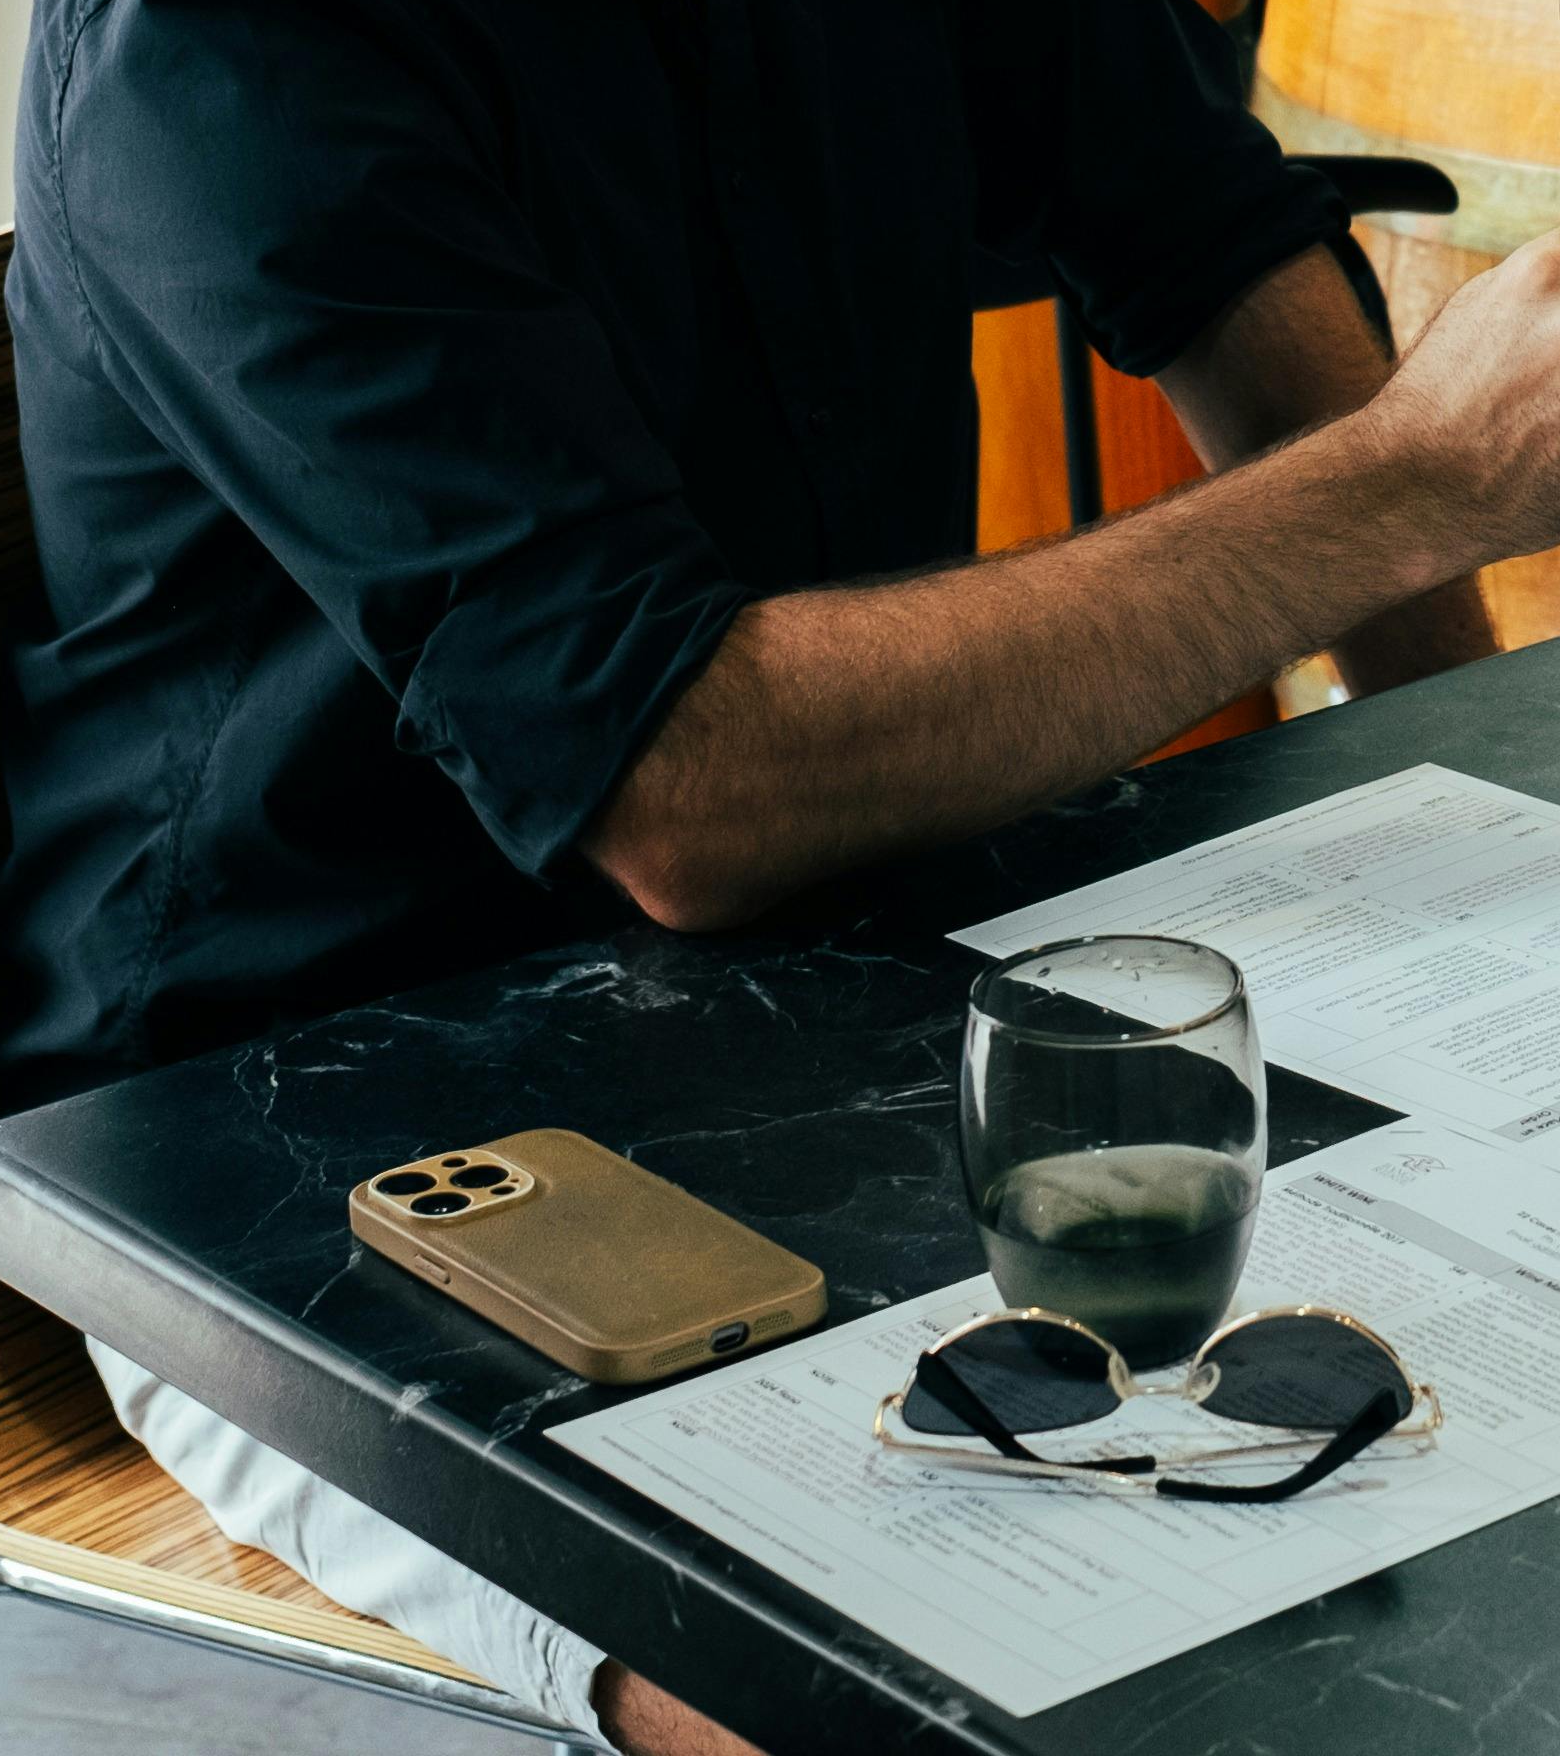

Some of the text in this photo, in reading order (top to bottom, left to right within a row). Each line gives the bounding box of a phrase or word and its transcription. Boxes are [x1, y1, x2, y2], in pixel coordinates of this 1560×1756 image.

[1516, 1110, 1554, 1126] Order
[1311, 1174, 1379, 1204] WHITE WINE
